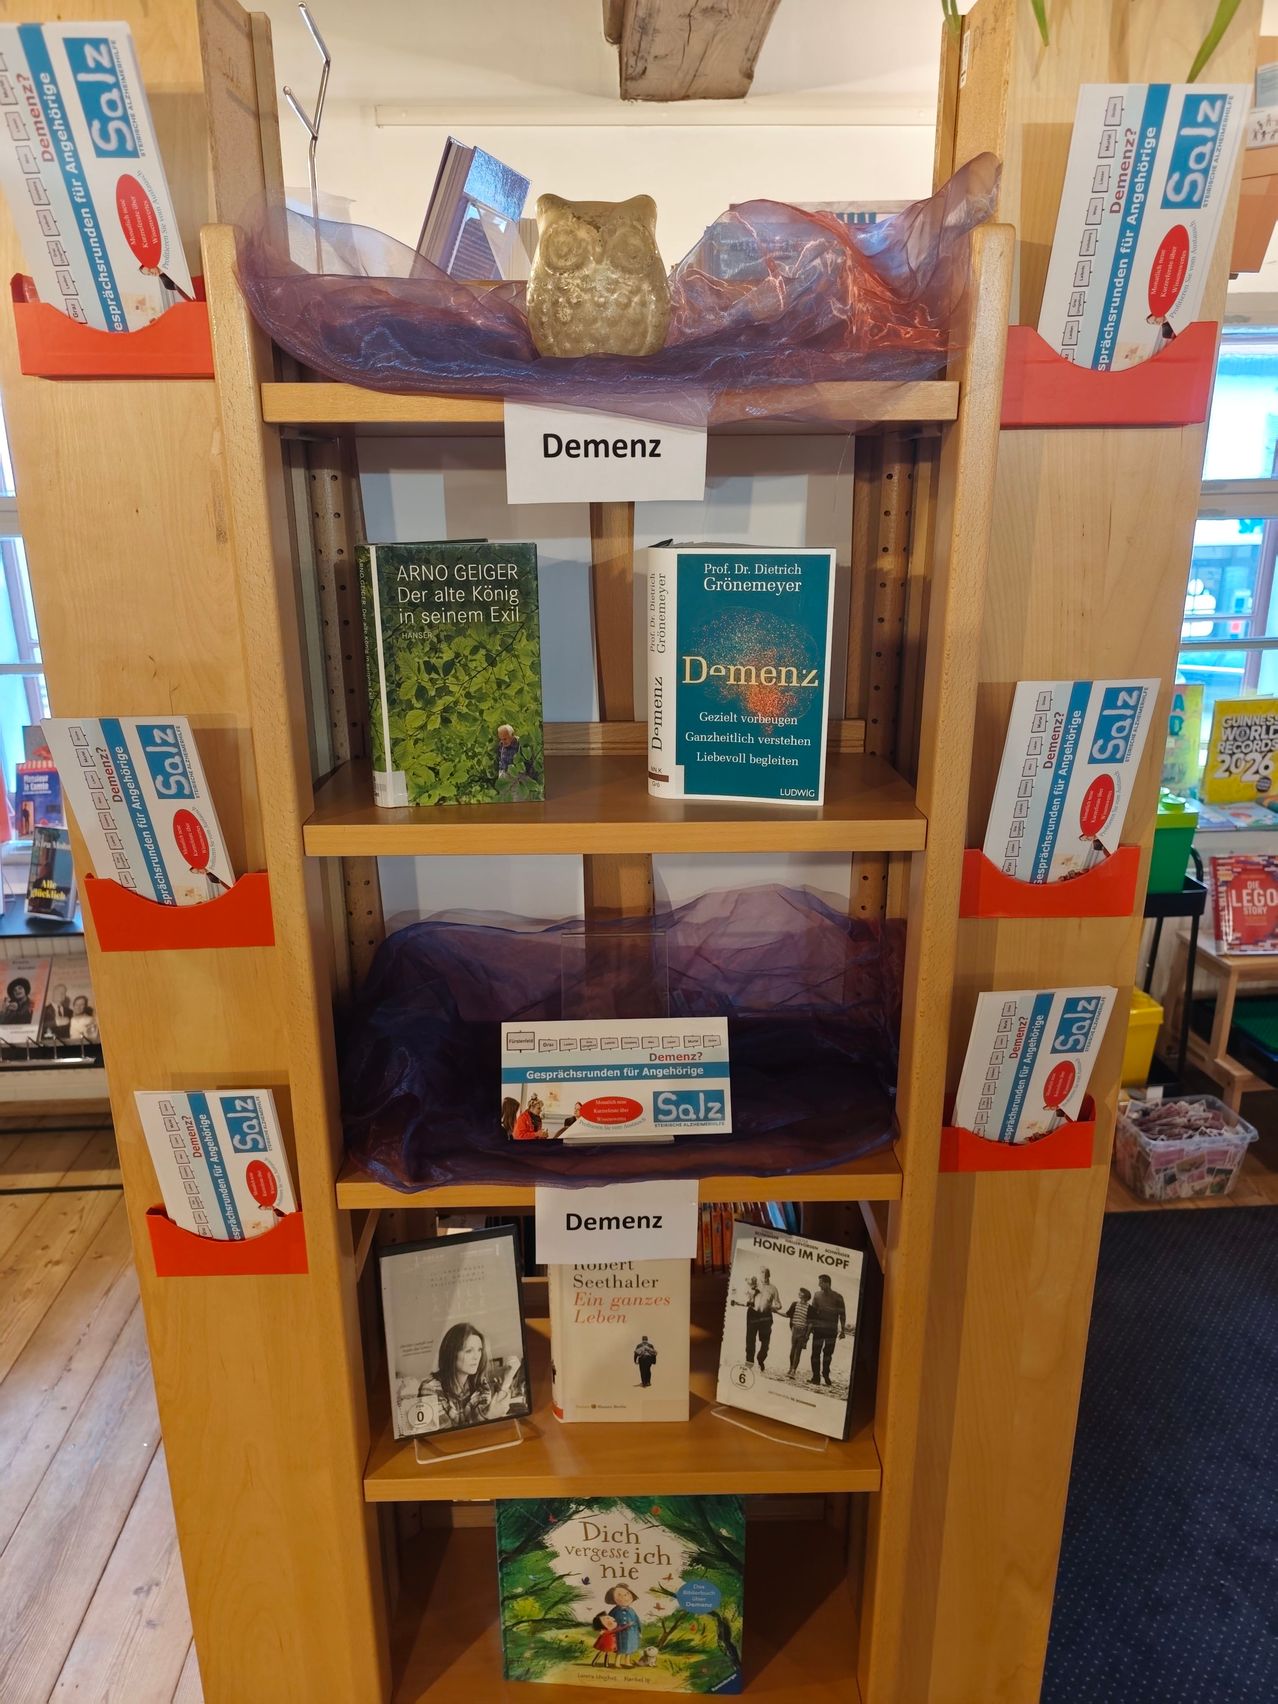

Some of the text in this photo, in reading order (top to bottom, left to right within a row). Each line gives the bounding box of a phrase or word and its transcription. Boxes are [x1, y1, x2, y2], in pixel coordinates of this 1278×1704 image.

[76, 43, 132, 150] Salz
[18, 73, 55, 162] Demenz?
[1165, 99, 1222, 202] Salz
[1109, 127, 1136, 213] Demenz?
[40, 72, 124, 331] esprächsrunden für Angehörige
[1097, 126, 1155, 370] sprächsrunden für Angehörige
[542, 433, 662, 458] Demenz
[397, 564, 518, 582] ARNO GEIGER
[704, 563, 802, 575] Prof. Dr. Dietrich
[398, 586, 520, 605] Der alte König
[704, 576, 802, 596] Grönemeyer
[400, 606, 520, 624] in seinem Exil
[656, 573, 668, 654] Grönemeyer
[402, 632, 433, 640] HANSER
[682, 656, 819, 687] Demenz
[651, 676, 663, 751] Demenz
[699, 712, 798, 725] Gezielt vorbeugen
[1091, 690, 1139, 759] Salz
[685, 732, 811, 746] Ganzheitlich verstehen
[1042, 711, 1063, 768] Demenz?
[1057, 710, 1080, 775] Angehörige
[1222, 726, 1278, 740] WORLD
[1216, 739, 1278, 754] RECORDS
[145, 728, 189, 794] Salz
[696, 752, 799, 766] Liebevoll begleiten
[1214, 751, 1274, 784] 2026
[95, 747, 123, 802] Demenz?
[780, 788, 815, 798] LUDWIG
[1053, 779, 1064, 794] für
[114, 746, 173, 904] sprächsrunden für Angehörige
[1232, 888, 1278, 907] LEGO
[1243, 906, 1267, 915] STORY
[1054, 999, 1097, 1050] Salz
[1008, 1016, 1028, 1058] Demenz?
[1022, 1015, 1043, 1063] Angehörige
[649, 1052, 702, 1062] Demenz?
[526, 1066, 703, 1080] Gesprächsrunden für Angehörige
[1018, 1065, 1029, 1077] für
[657, 1092, 721, 1120] Salz
[226, 1099, 263, 1149] Salz
[181, 1115, 203, 1158] Demenz?
[198, 1114, 242, 1239] esprächsrunden für Angehörige
[566, 1213, 663, 1230] Demenz
[753, 1237, 796, 1256] HONIG
[798, 1248, 813, 1261] IM
[816, 1253, 850, 1270] KOPF
[573, 1274, 659, 1289] Seethaler
[574, 1291, 671, 1311] Ein ganzes
[574, 1309, 627, 1324] Leben
[738, 1373, 746, 1384] 6
[417, 1411, 424, 1422] 0
[579, 1521, 641, 1544] Dich
[564, 1545, 672, 1566] vergesse ich
[600, 1562, 639, 1580] nie
